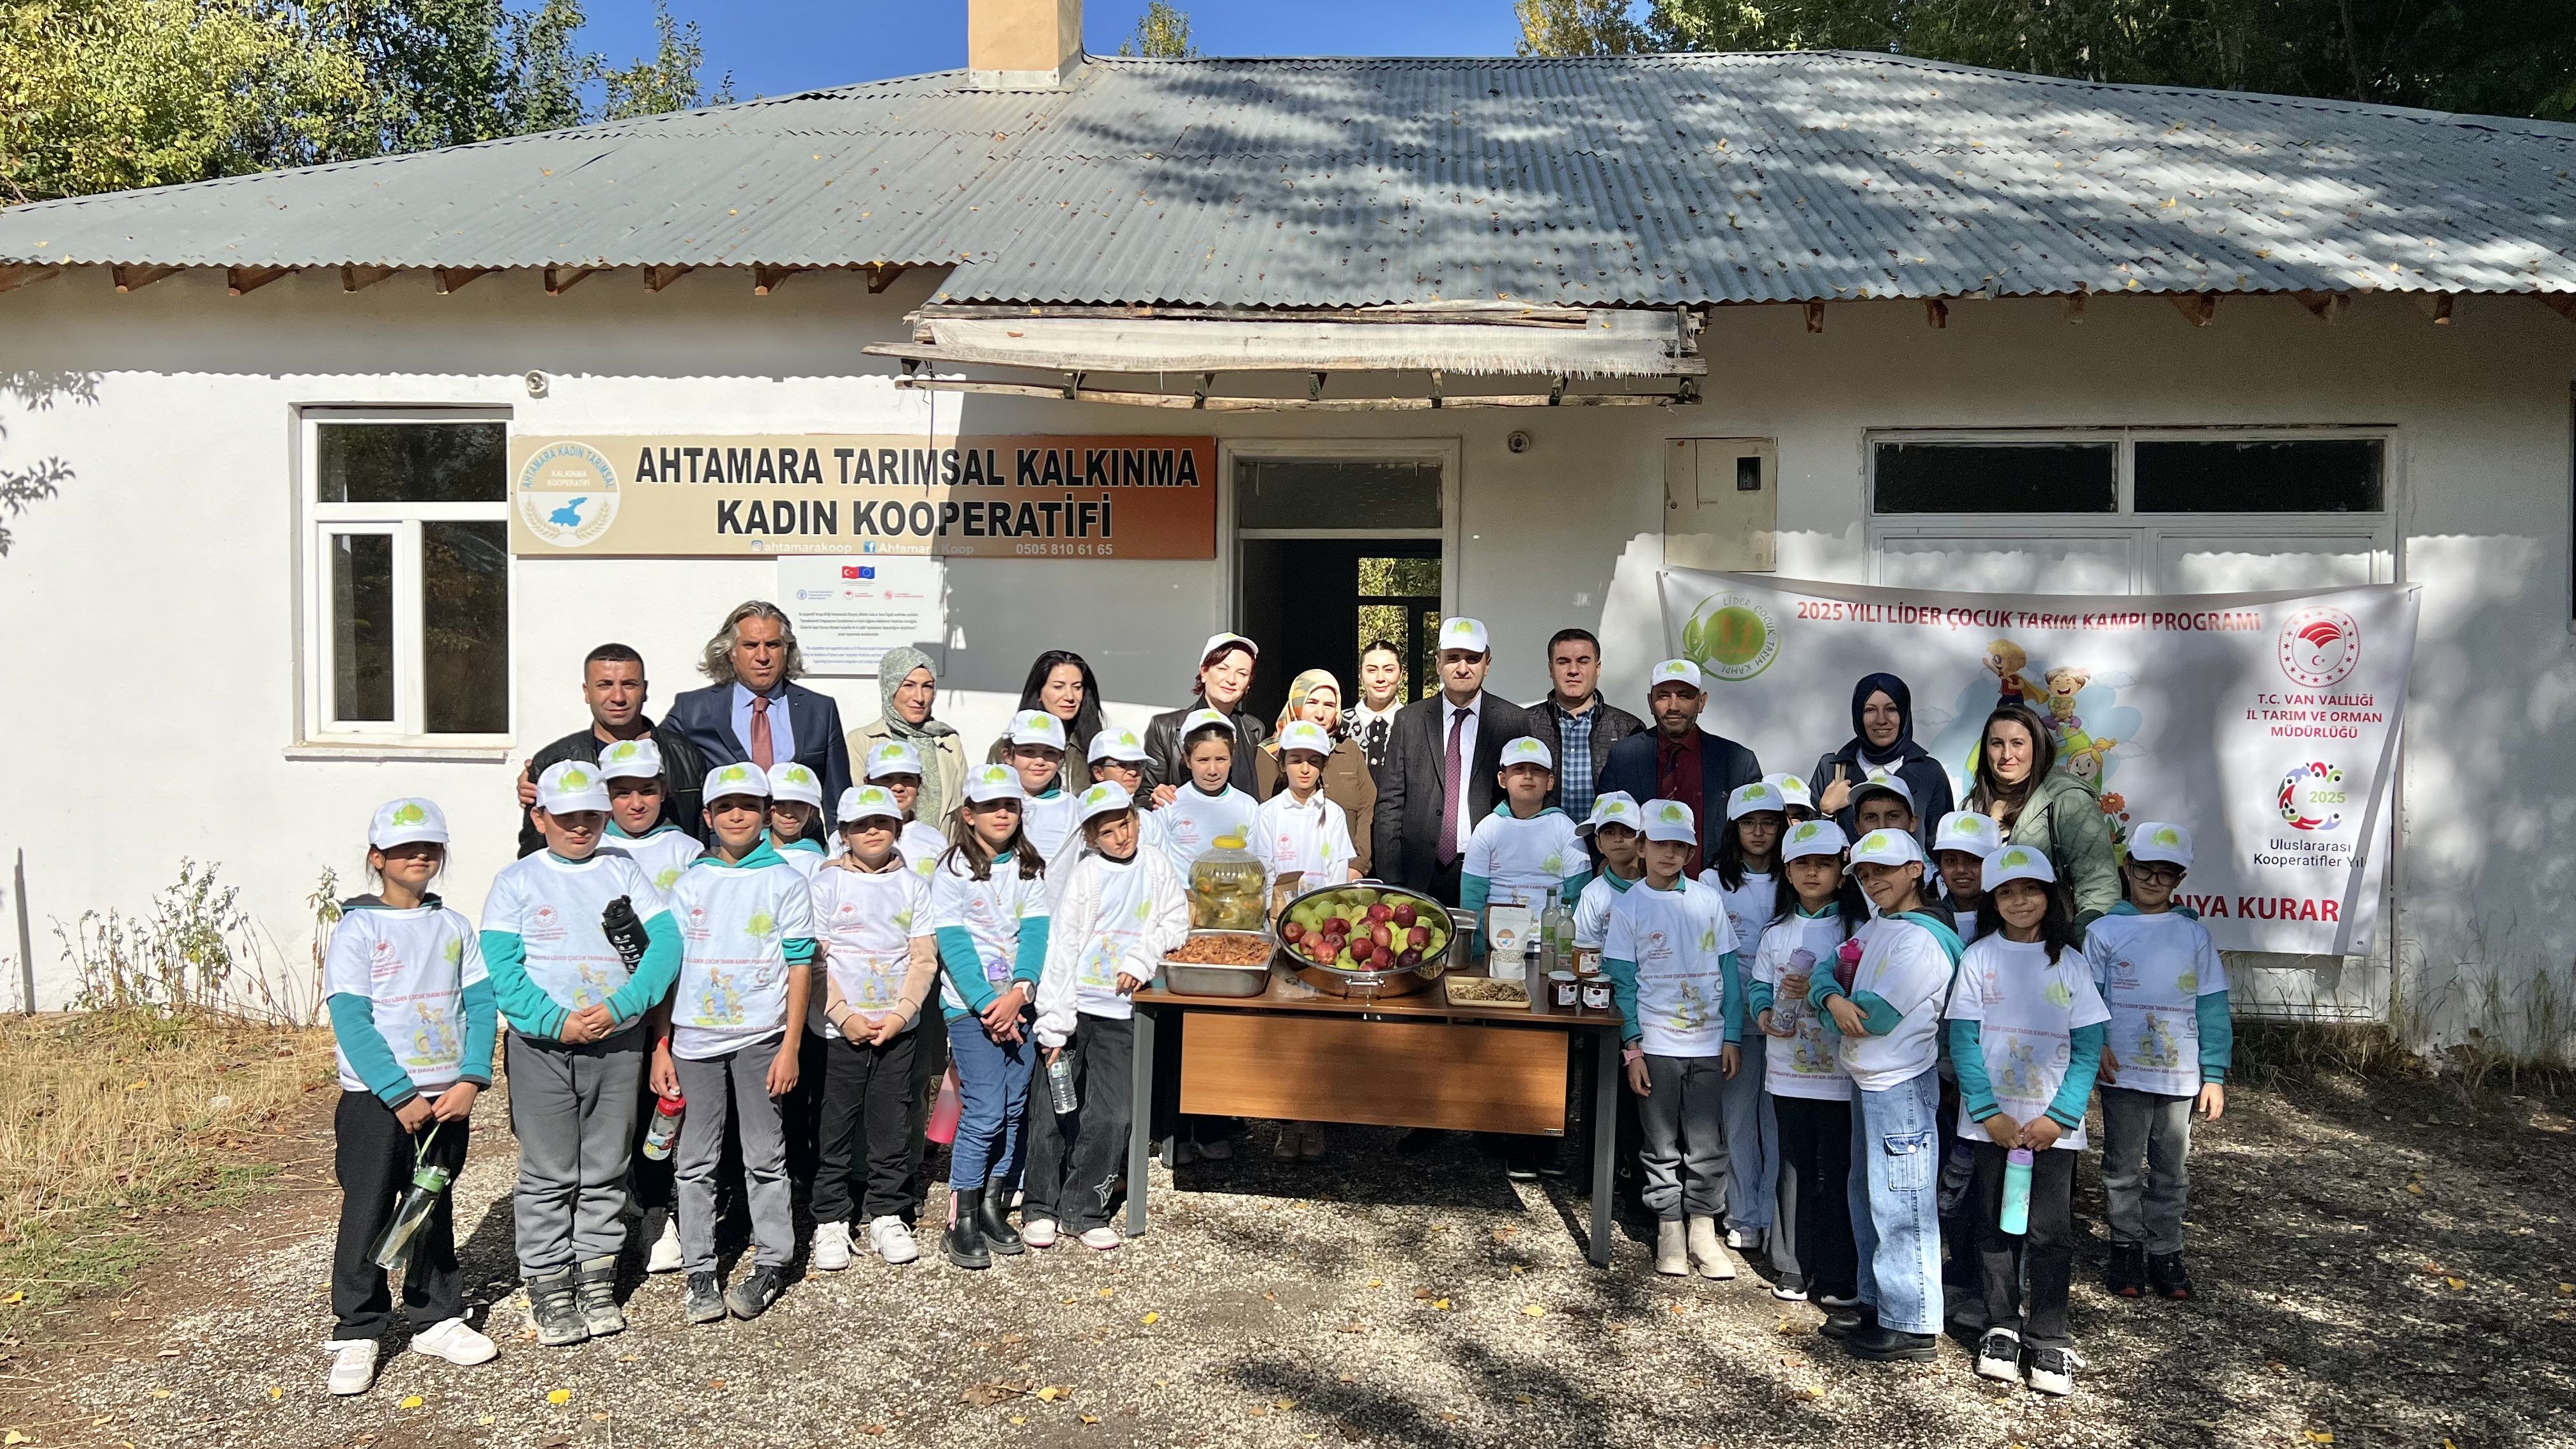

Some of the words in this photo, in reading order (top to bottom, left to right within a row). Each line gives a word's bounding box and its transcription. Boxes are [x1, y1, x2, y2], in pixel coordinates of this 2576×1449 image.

[521, 449, 556, 489] AHTAMARA
[558, 446, 584, 458] KADIN
[587, 450, 615, 489] TARIMSAL
[635, 447, 825, 485] AHTAMARA
[834, 447, 1005, 487] TARIMSAL
[1016, 448, 1200, 487] KALKINMA
[717, 499, 838, 536] KADIN
[853, 493, 1112, 538] KOOPERATİFİ
[764, 542, 852, 554] ahtamarakoop
[878, 543, 937, 553] Ahtamara
[941, 544, 974, 555] Koop
[1016, 544, 1046, 555] 0505
[1051, 544, 1074, 555] 810
[1078, 544, 1092, 555] 61
[1097, 544, 1113, 555] 65
[1797, 601, 1843, 620] 2025
[1847, 603, 1882, 622] YILI
[1887, 601, 1942, 625] LİDER
[1947, 608, 2012, 631] ÇOCUK
[2018, 611, 2077, 630] TARIM
[2082, 612, 2147, 631] KAMPI
[2152, 611, 2261, 631] PROGRAMI
[1754, 641, 1775, 666] TARIM
[1722, 664, 1752, 675] KAMPI
[2258, 694, 2280, 704] T.C.
[2285, 694, 2314, 705] VAN
[2319, 693, 2373, 706] VALİLİĞİ
[2246, 708, 2258, 720] İL
[2262, 710, 2306, 721] TARIM
[2310, 711, 2327, 721] VE
[2330, 711, 2382, 723] ORMAN
[2271, 724, 2358, 739] MÜDÜRLÜĞÜ
[2309, 791, 2346, 804] 2025
[2270, 838, 2351, 852] Uluslararası
[2253, 853, 2342, 868] Kooperatifler
[2347, 856, 2364, 868] Yıl
[2174, 894, 2229, 917] NYA
[2238, 896, 2339, 922] KURAR
